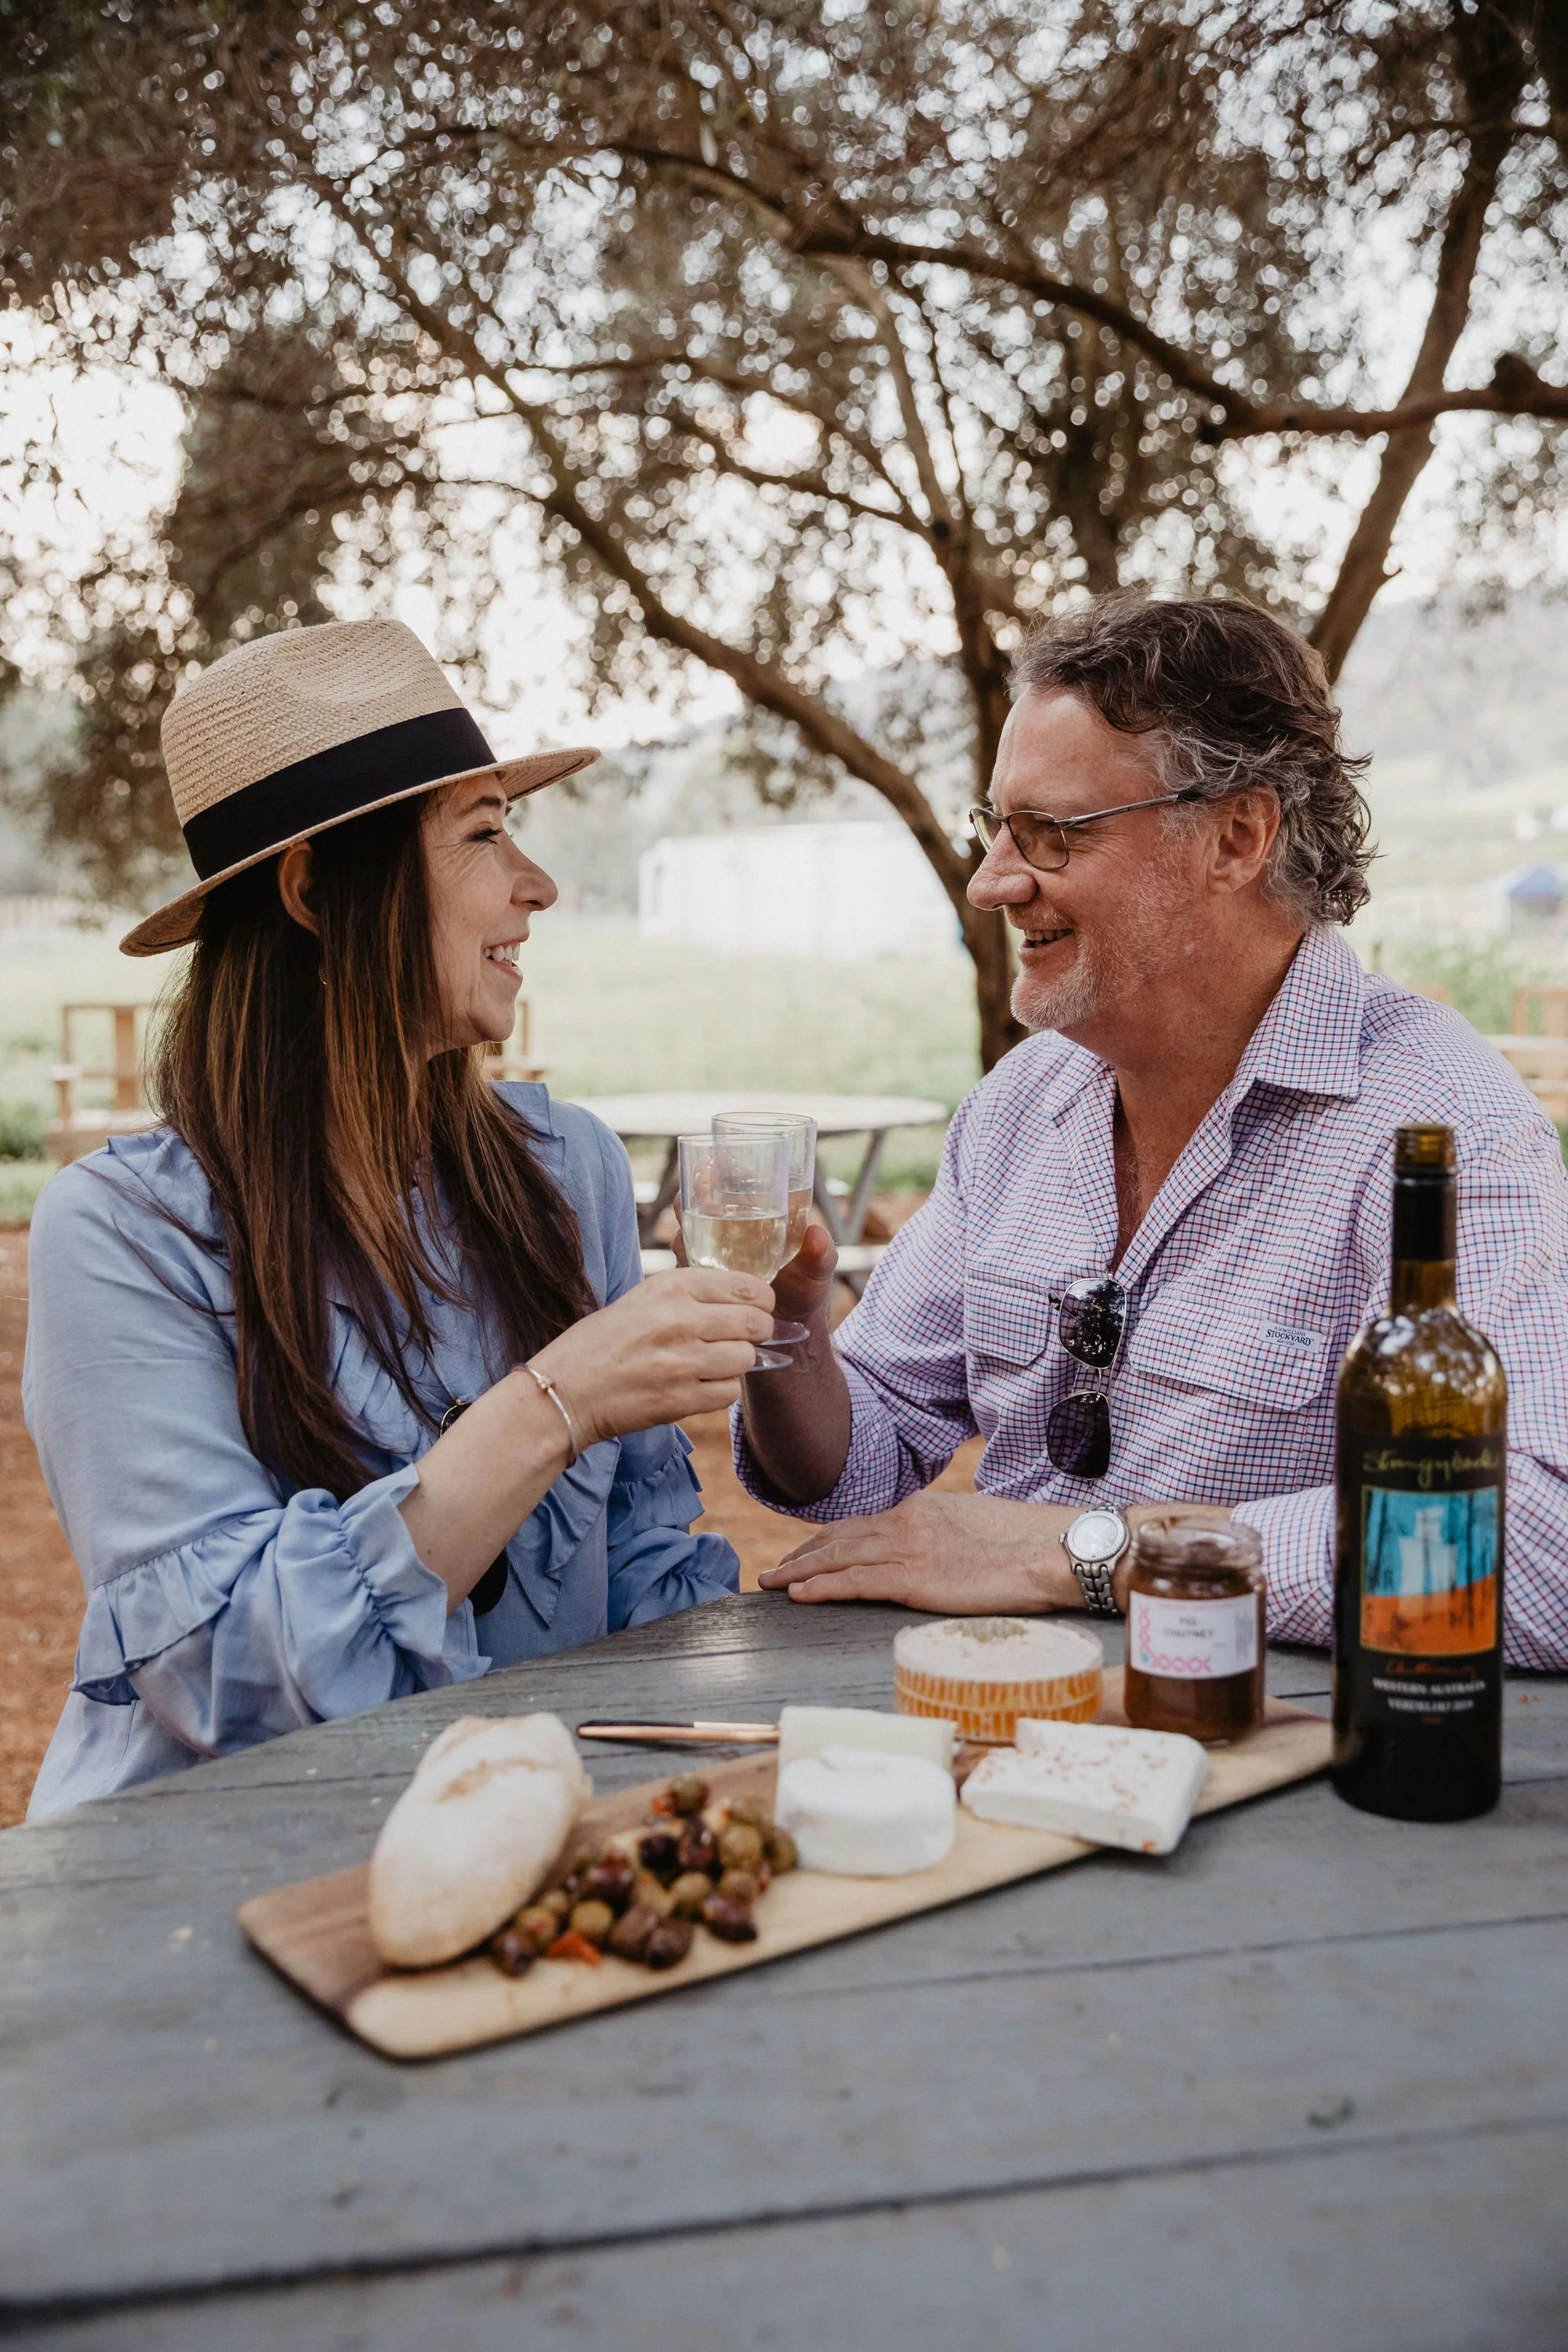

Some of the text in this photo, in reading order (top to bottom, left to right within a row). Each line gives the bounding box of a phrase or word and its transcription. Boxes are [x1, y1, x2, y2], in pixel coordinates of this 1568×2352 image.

[1265, 1329, 1312, 1346] STOCKYARD
[1178, 1616, 1197, 1626] FIG
[1163, 1628, 1214, 1639] CHUTNEY
